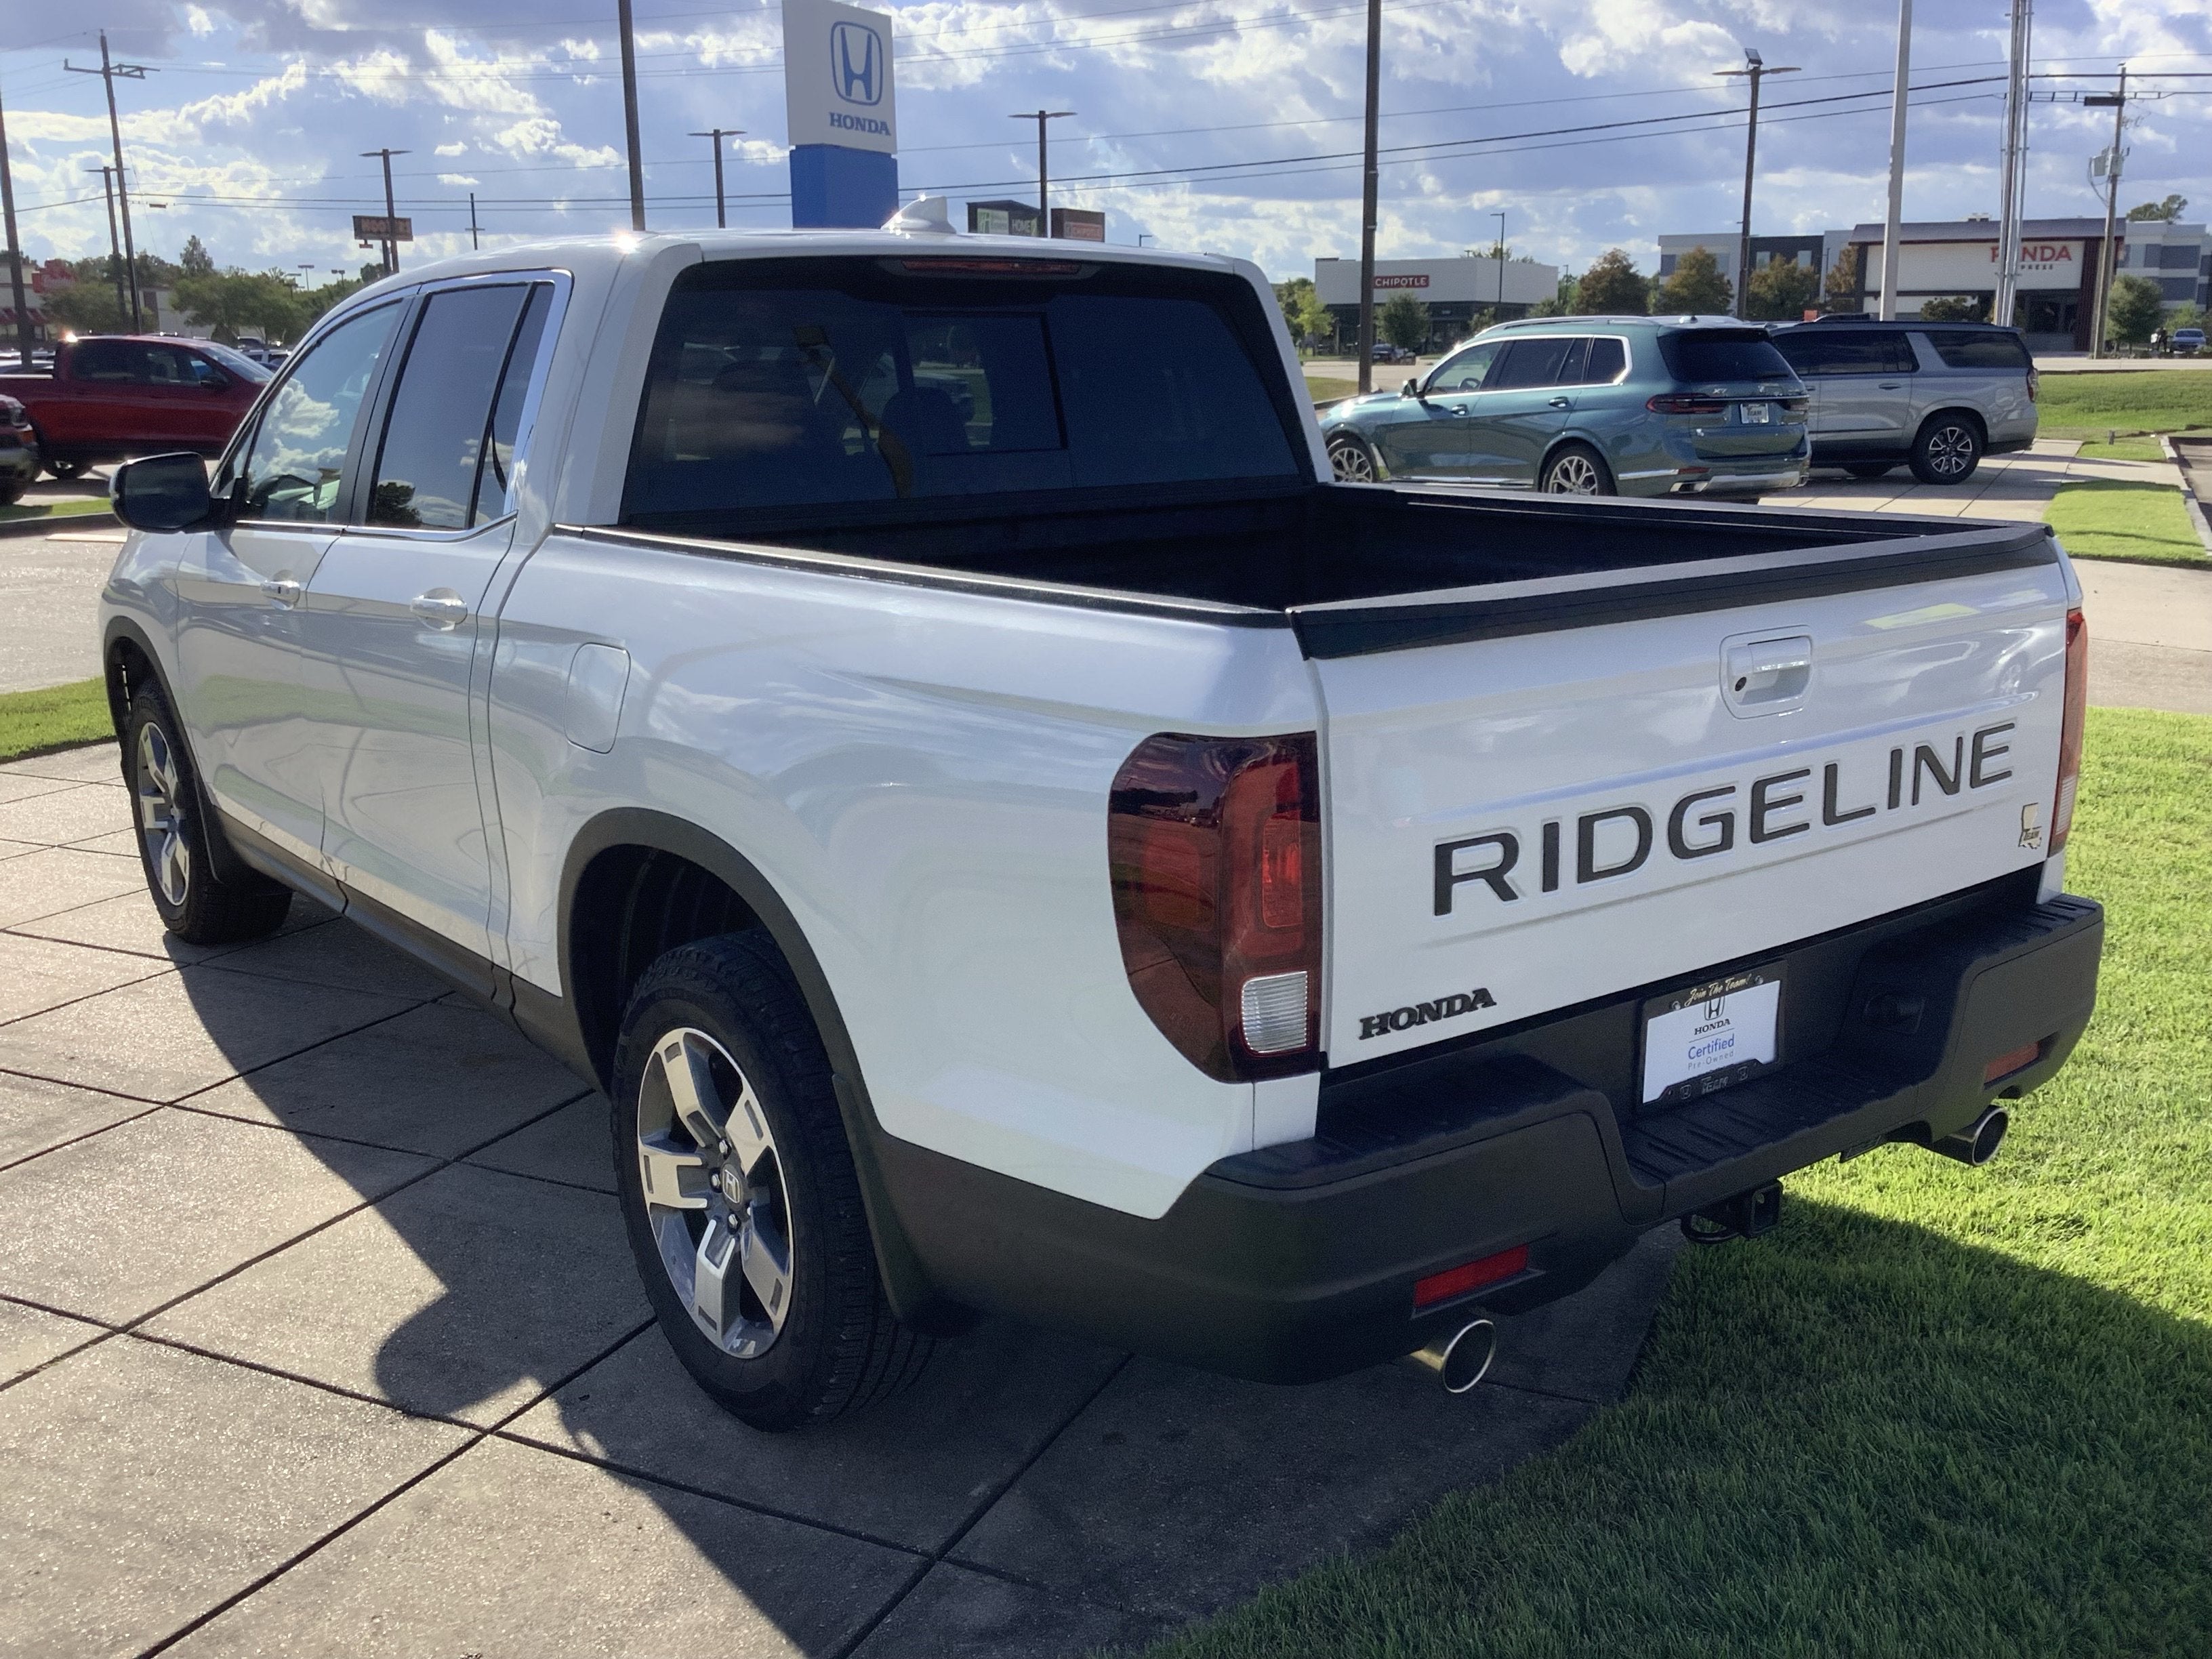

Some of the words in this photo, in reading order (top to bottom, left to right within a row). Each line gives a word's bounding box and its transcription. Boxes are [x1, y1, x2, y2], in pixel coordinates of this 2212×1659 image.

[829, 111, 892, 136] HONDA
[1990, 245, 2072, 263] PNDA
[1374, 276, 1427, 287] CHIPOTLE
[1433, 722, 2015, 917] RIDGELINE
[1684, 988, 1707, 1007] Join
[1708, 982, 1723, 996] The
[1725, 973, 1752, 992] Team!
[1358, 987, 1498, 1041] HONDA
[1694, 1018, 1731, 1036] HONDA
[1687, 1033, 1735, 1060] Certified
[1687, 1051, 1734, 1071] Pre-Owned
